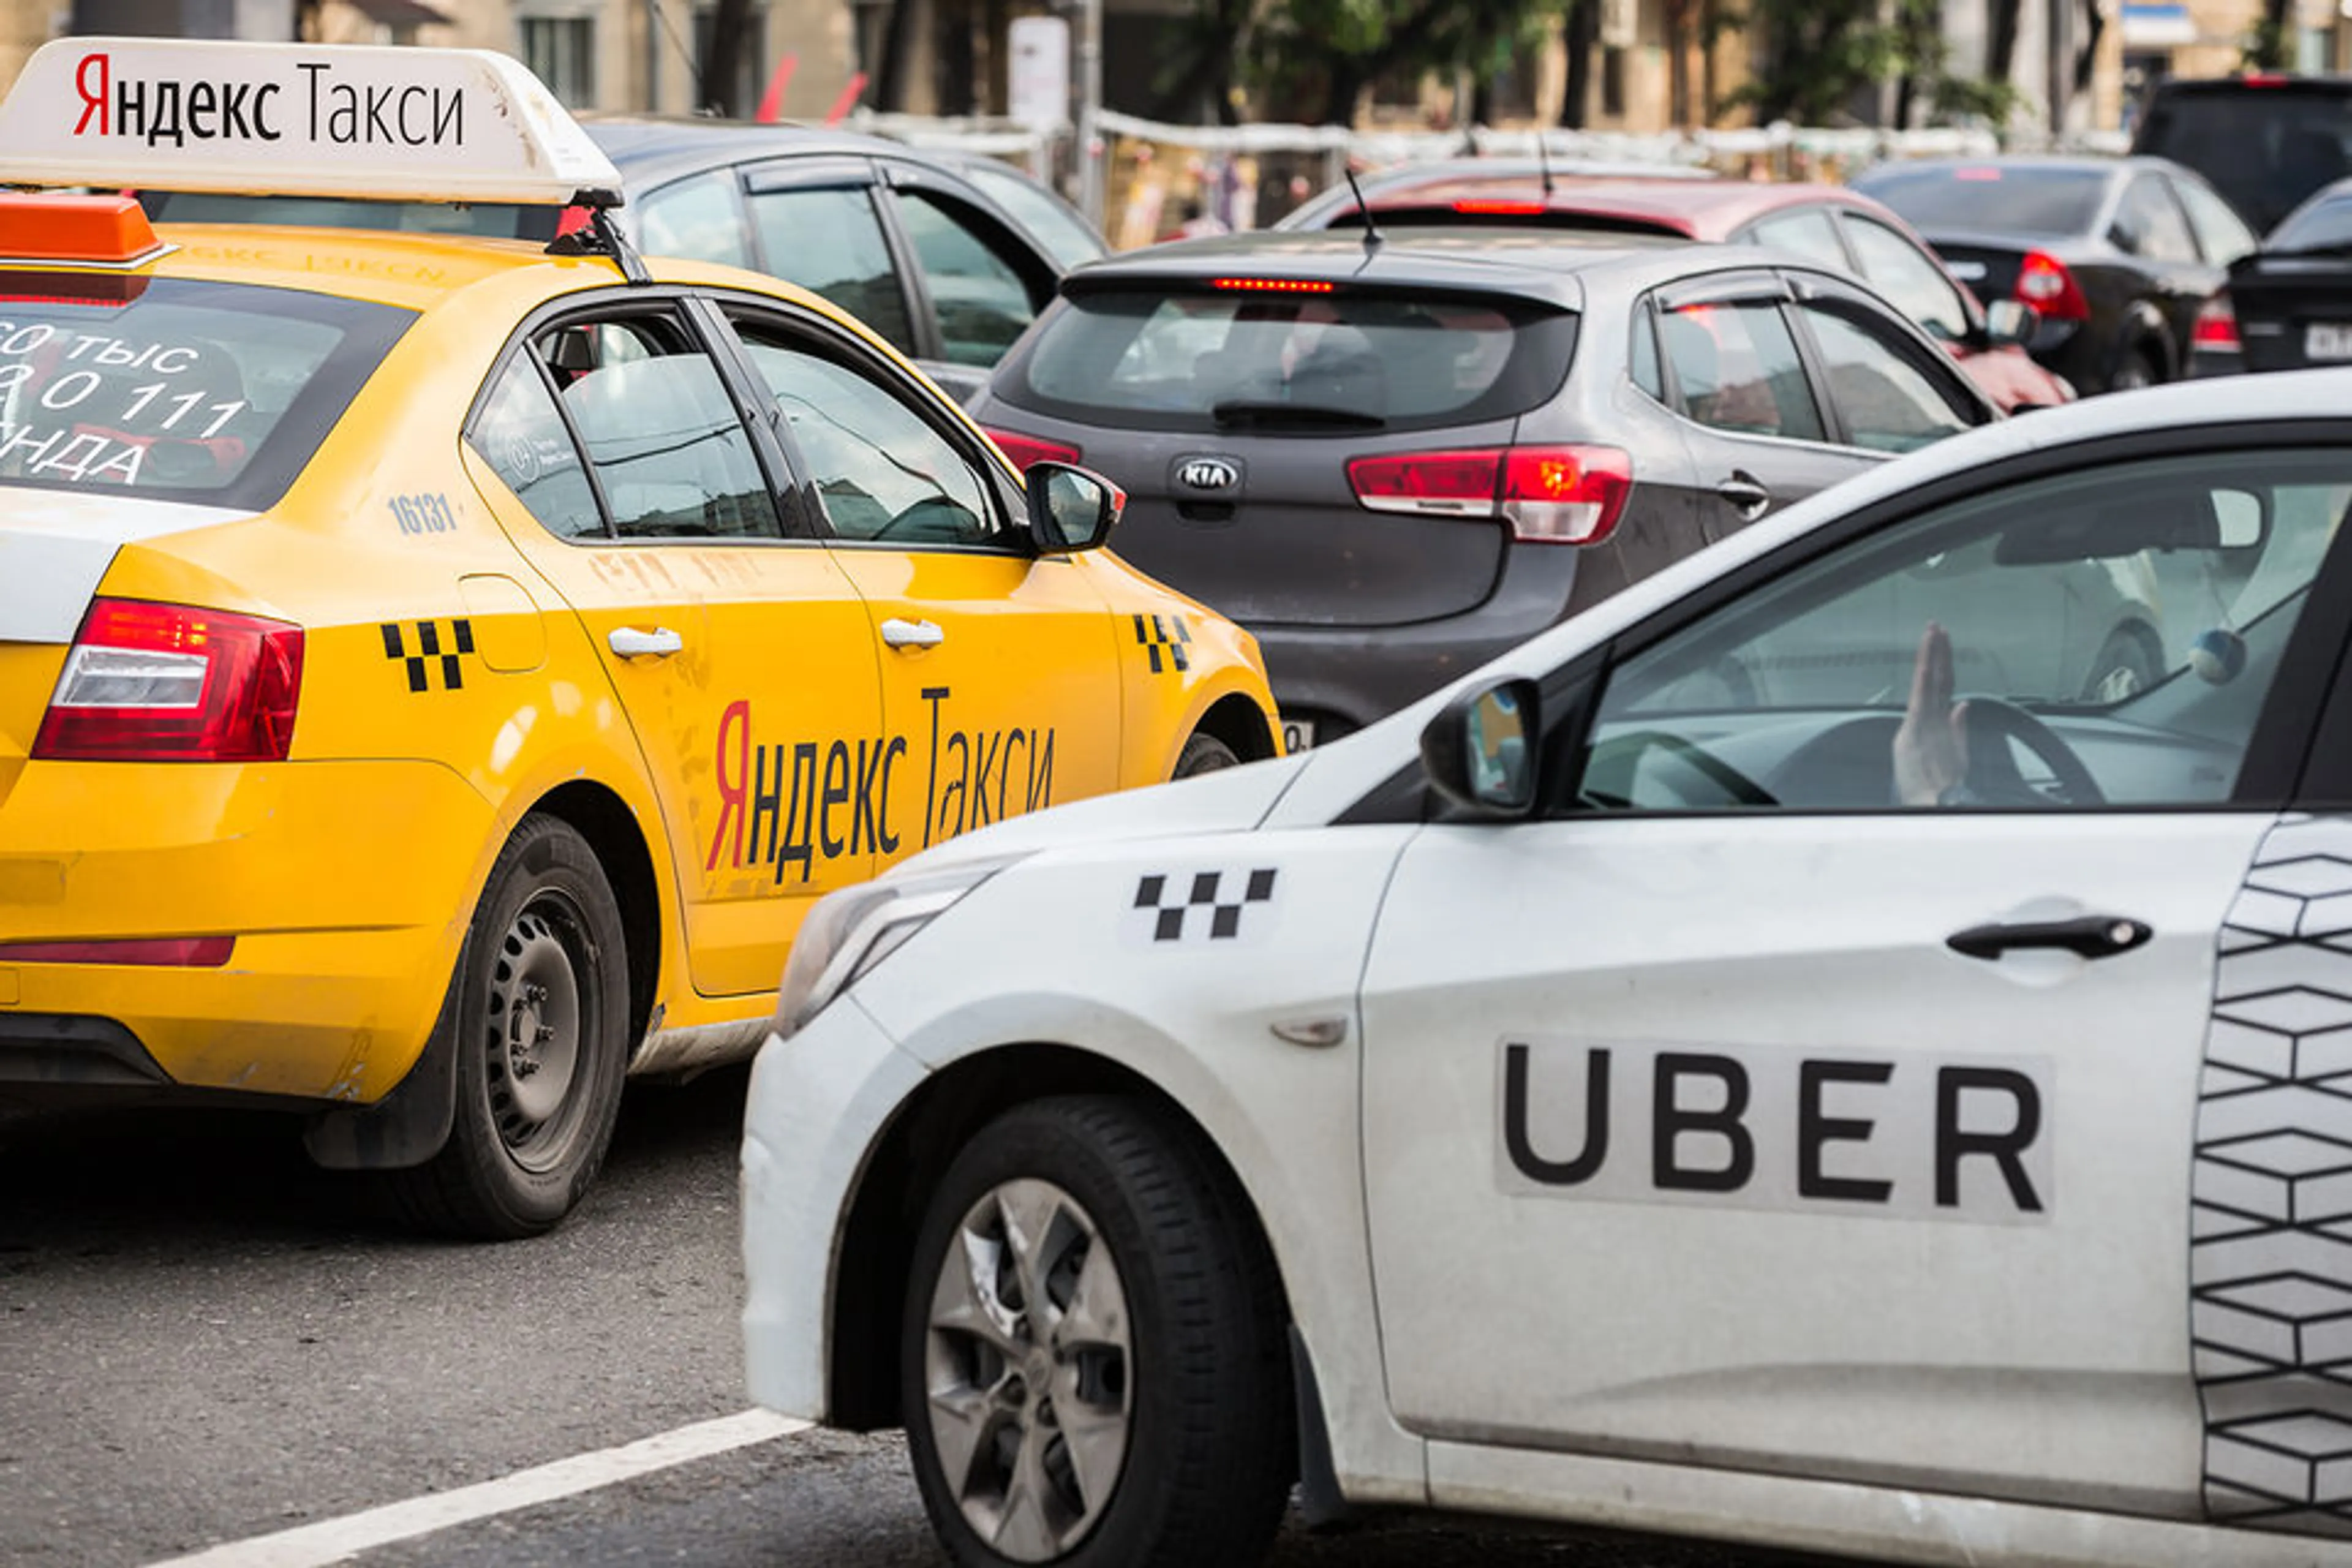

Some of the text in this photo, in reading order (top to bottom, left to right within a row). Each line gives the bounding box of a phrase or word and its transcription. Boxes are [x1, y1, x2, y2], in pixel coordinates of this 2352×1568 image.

[74, 53, 464, 148] Яндекс Такси
[0, 421, 145, 485] НДА
[1186, 464, 1225, 486] KIA
[387, 492, 457, 537] 16131
[706, 687, 1055, 884] Яндекс Такси
[1504, 1044, 2044, 1213] UBER
